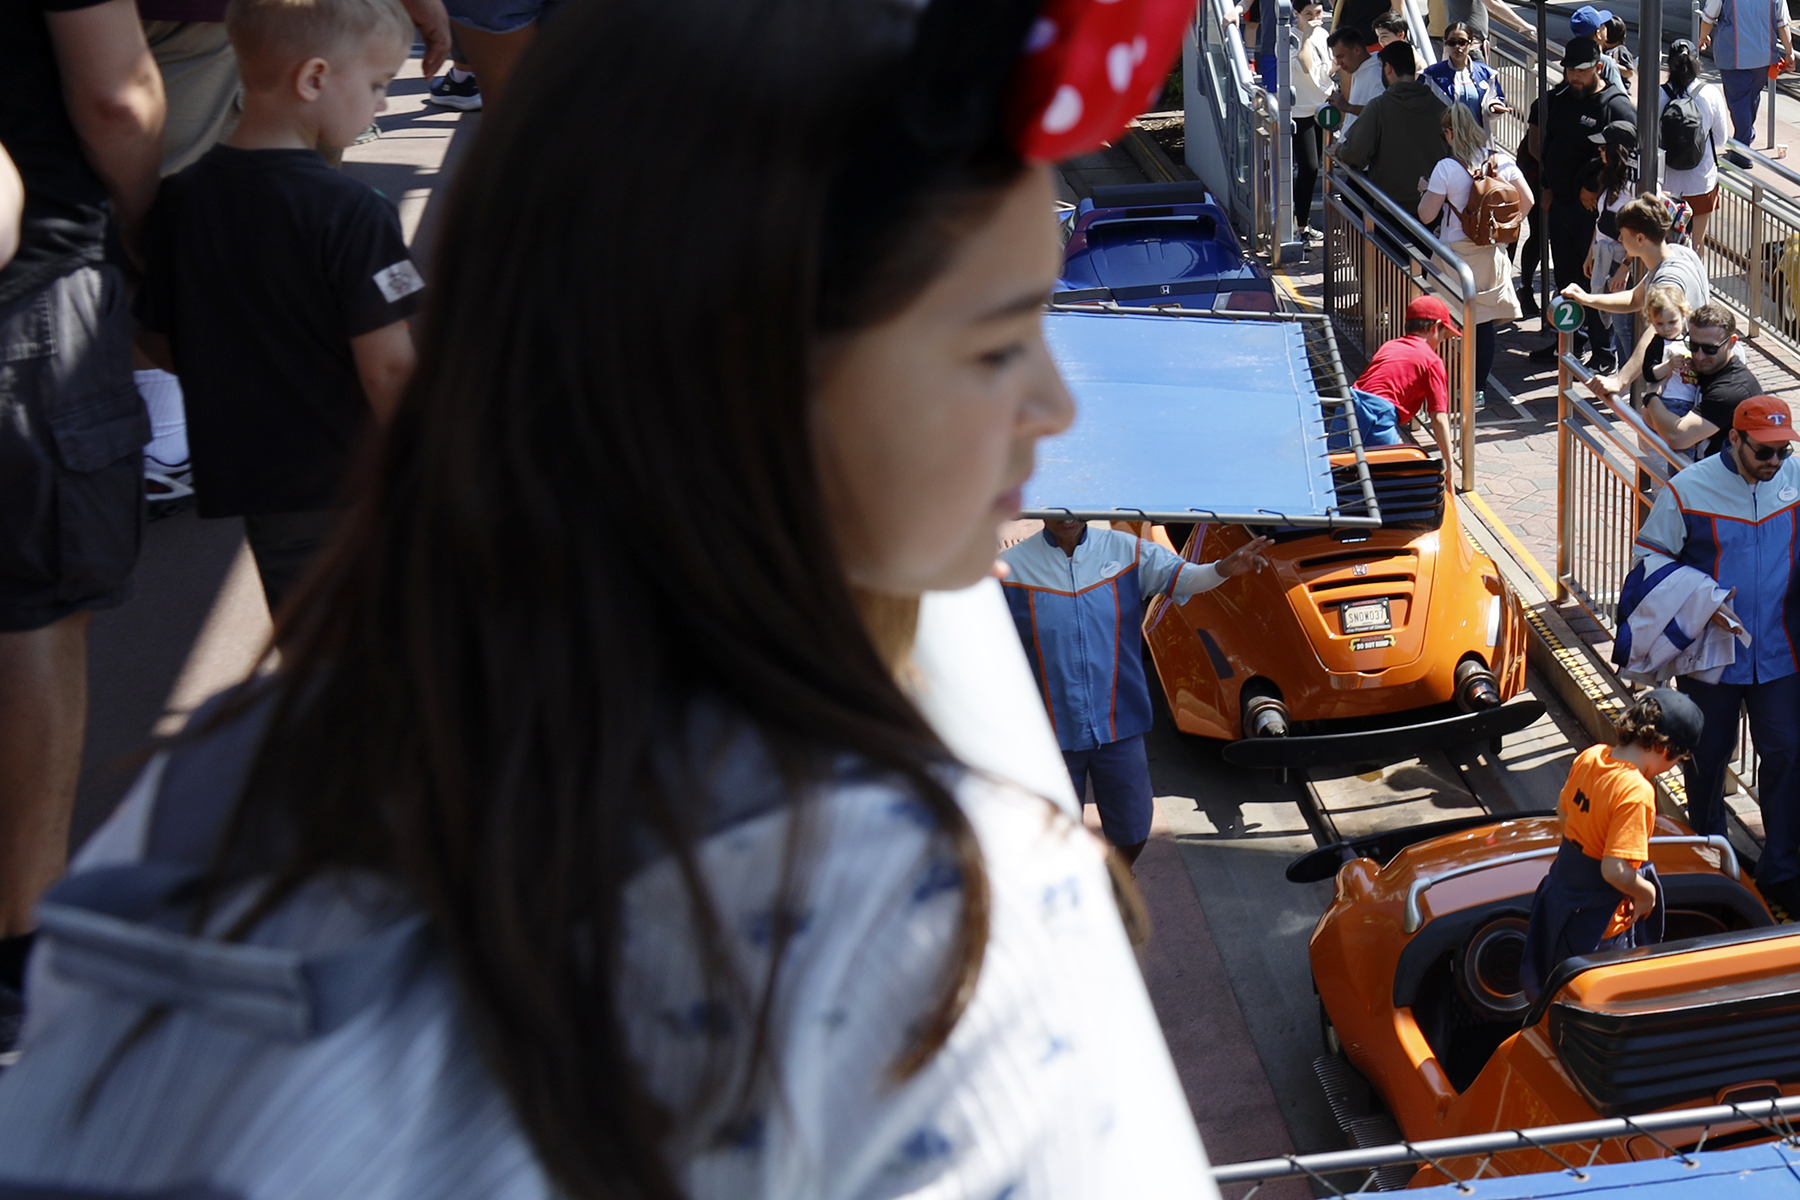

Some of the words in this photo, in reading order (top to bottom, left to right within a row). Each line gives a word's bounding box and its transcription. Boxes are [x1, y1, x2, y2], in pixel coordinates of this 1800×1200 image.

[1560, 304, 1573, 325] 2
[1767, 411, 1786, 426] T
[1356, 642, 1364, 650] DO
[1365, 641, 1375, 649] NOT
